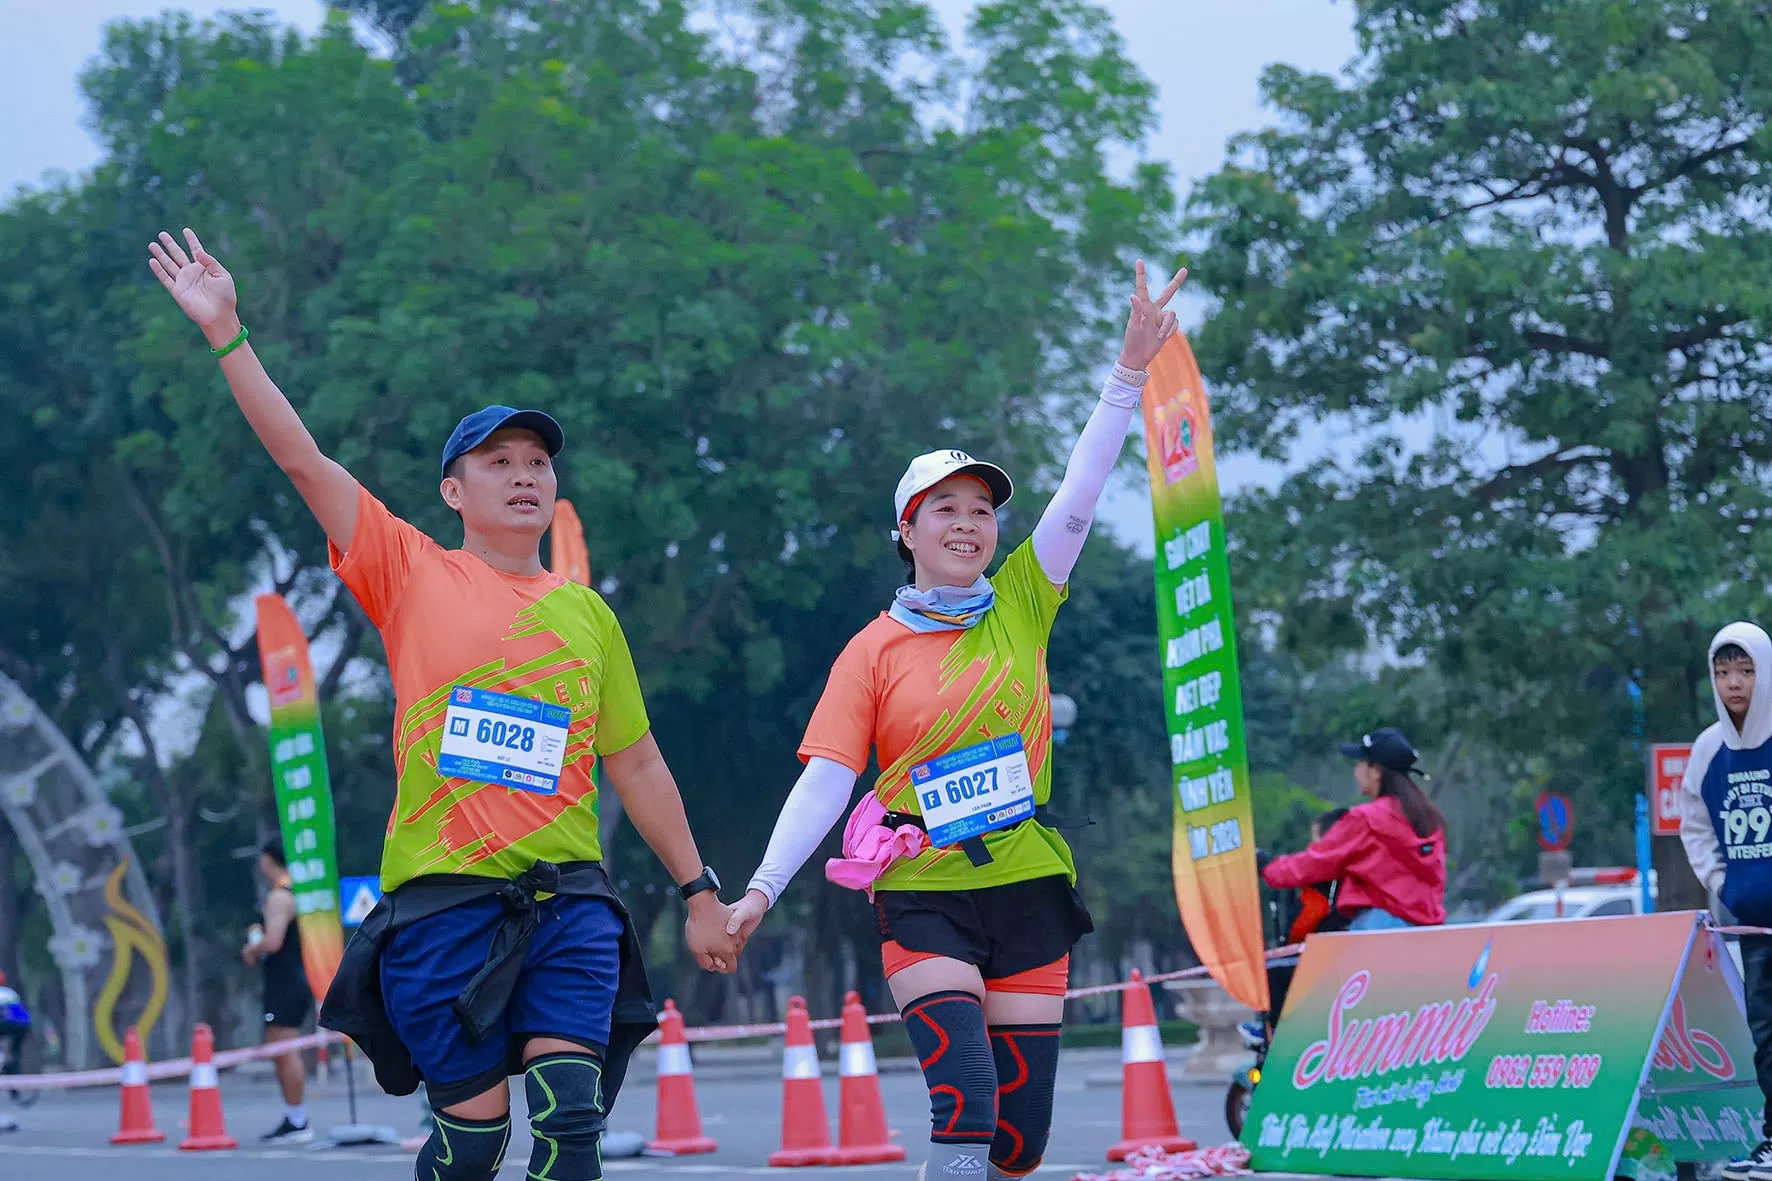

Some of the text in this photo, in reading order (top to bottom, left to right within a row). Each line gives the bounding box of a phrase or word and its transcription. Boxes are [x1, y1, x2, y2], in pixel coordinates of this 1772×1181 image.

[454, 720, 466, 734] M
[476, 718, 535, 752] 6028
[927, 793, 937, 808] F
[945, 766, 998, 804] 6027
[1719, 805, 1772, 845] 199
[1292, 969, 1498, 1090] Summit
[1525, 999, 1596, 1034] Hotline:
[1528, 1054, 1566, 1089] 559
[1561, 1053, 1602, 1089] 909
